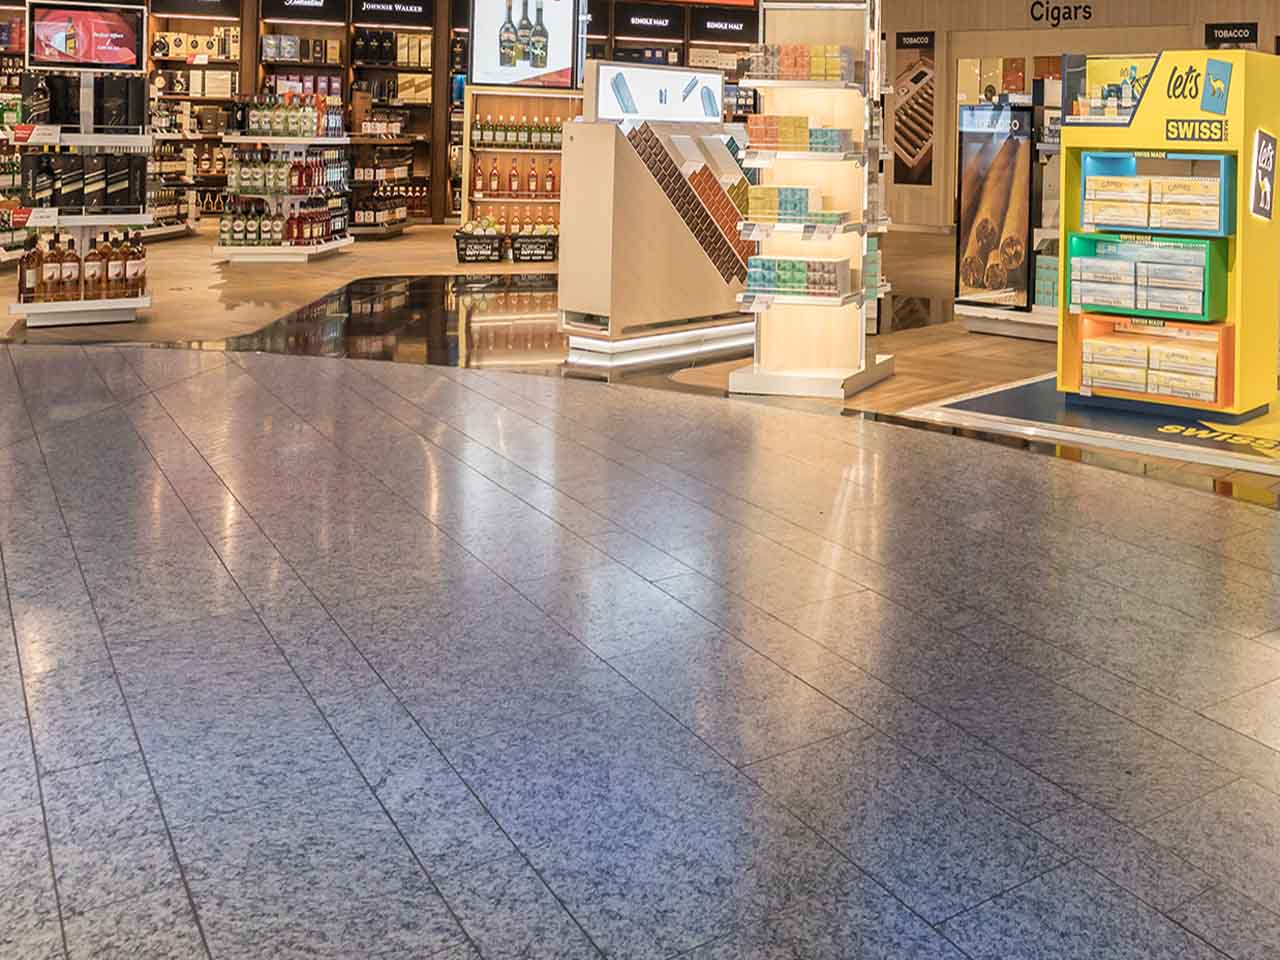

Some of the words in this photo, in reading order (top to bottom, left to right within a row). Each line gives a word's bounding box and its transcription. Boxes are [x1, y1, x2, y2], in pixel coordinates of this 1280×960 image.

[394, 3, 423, 13] WALKER
[1030, 0, 1092, 28] Cigars
[1214, 28, 1250, 38] TOBACCO
[902, 36, 929, 44] TOBACCO
[1167, 121, 1221, 140] SWISS
